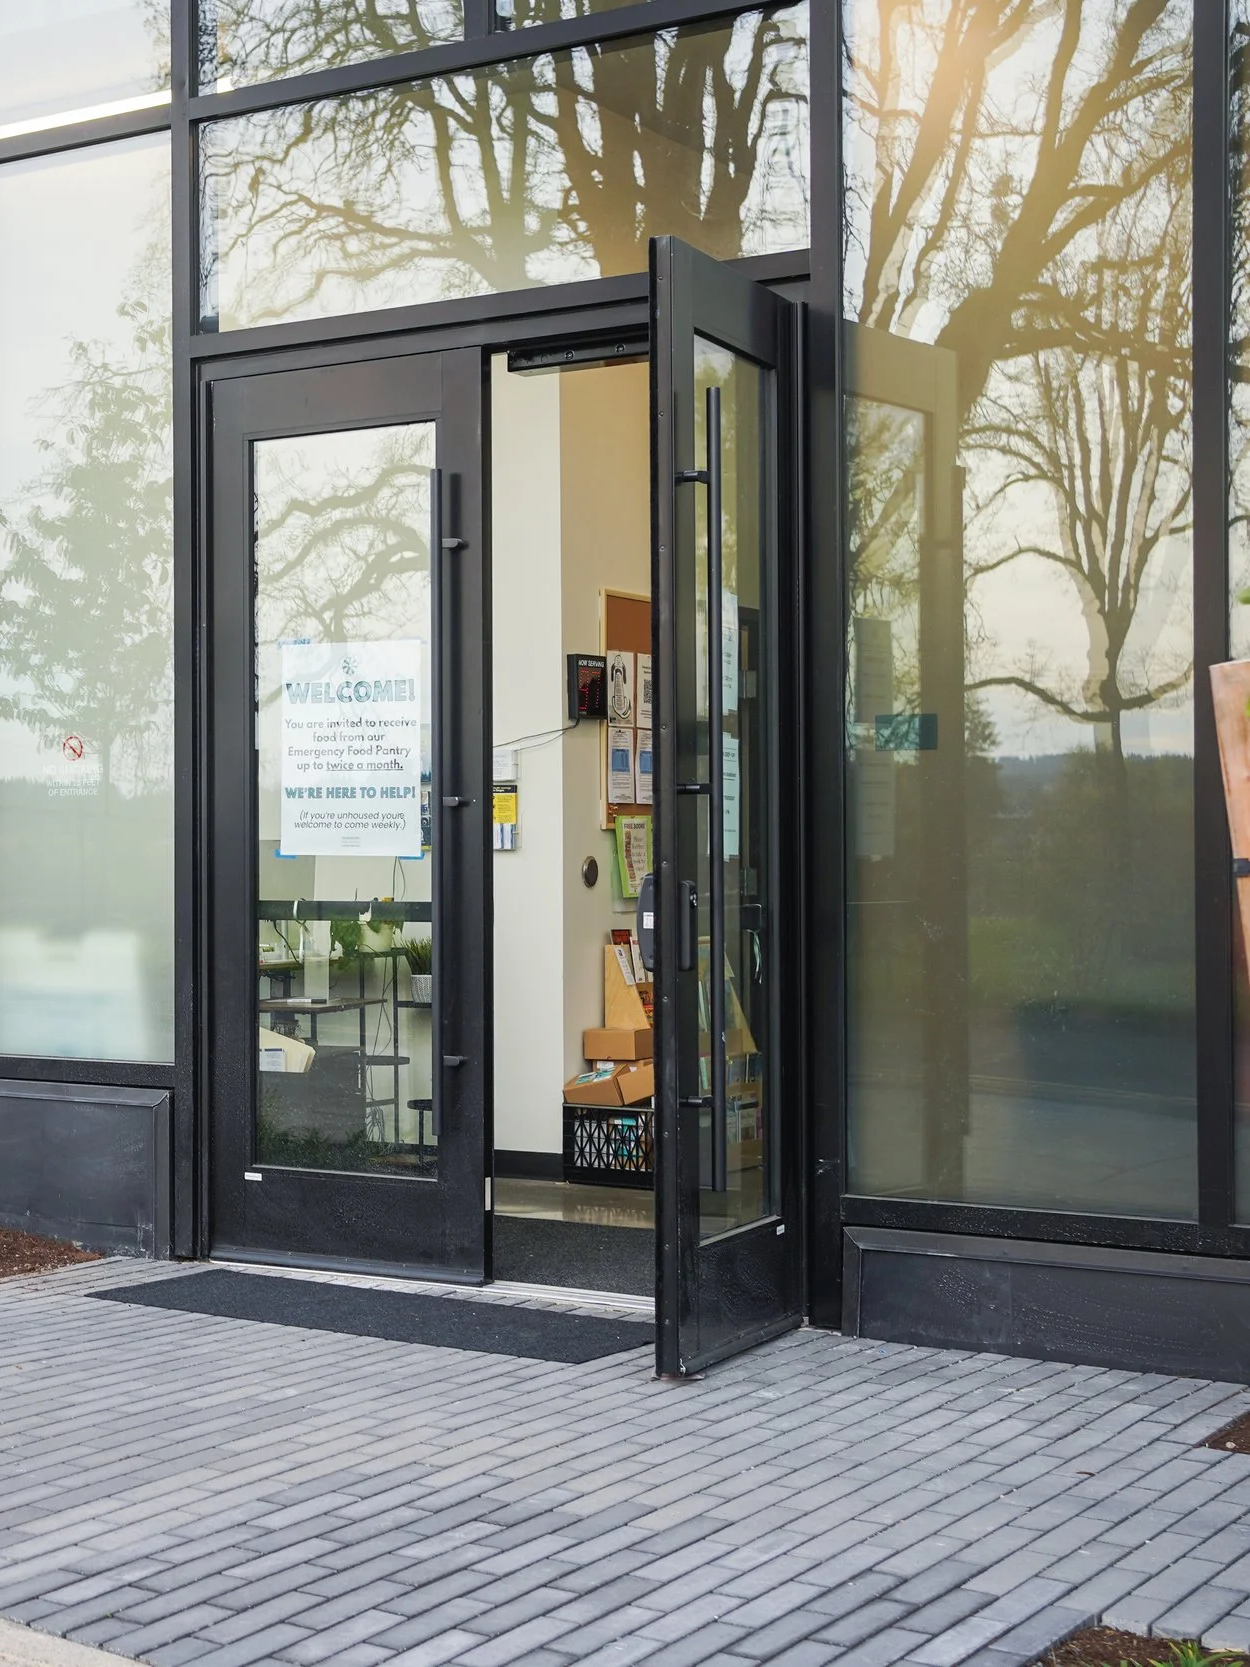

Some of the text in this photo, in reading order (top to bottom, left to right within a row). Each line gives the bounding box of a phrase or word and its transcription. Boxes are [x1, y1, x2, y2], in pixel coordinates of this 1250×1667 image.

[588, 660, 605, 668] SERVING
[285, 679, 415, 704] WELCOME!
[285, 716, 417, 729] You are invited to receive
[312, 731, 386, 742] food from our
[288, 745, 411, 758] Emergency Food Pantry
[296, 758, 404, 773] up to twice a month.
[83, 778, 99, 787] FEET
[60, 788, 99, 796] ENTRANCE
[285, 786, 416, 799] WE'RE HERE TO HELP!
[299, 809, 309, 821] (If
[310, 812, 336, 821] you're
[337, 811, 380, 820] unhoused
[294, 818, 406, 831] welcome to come weekly.)
